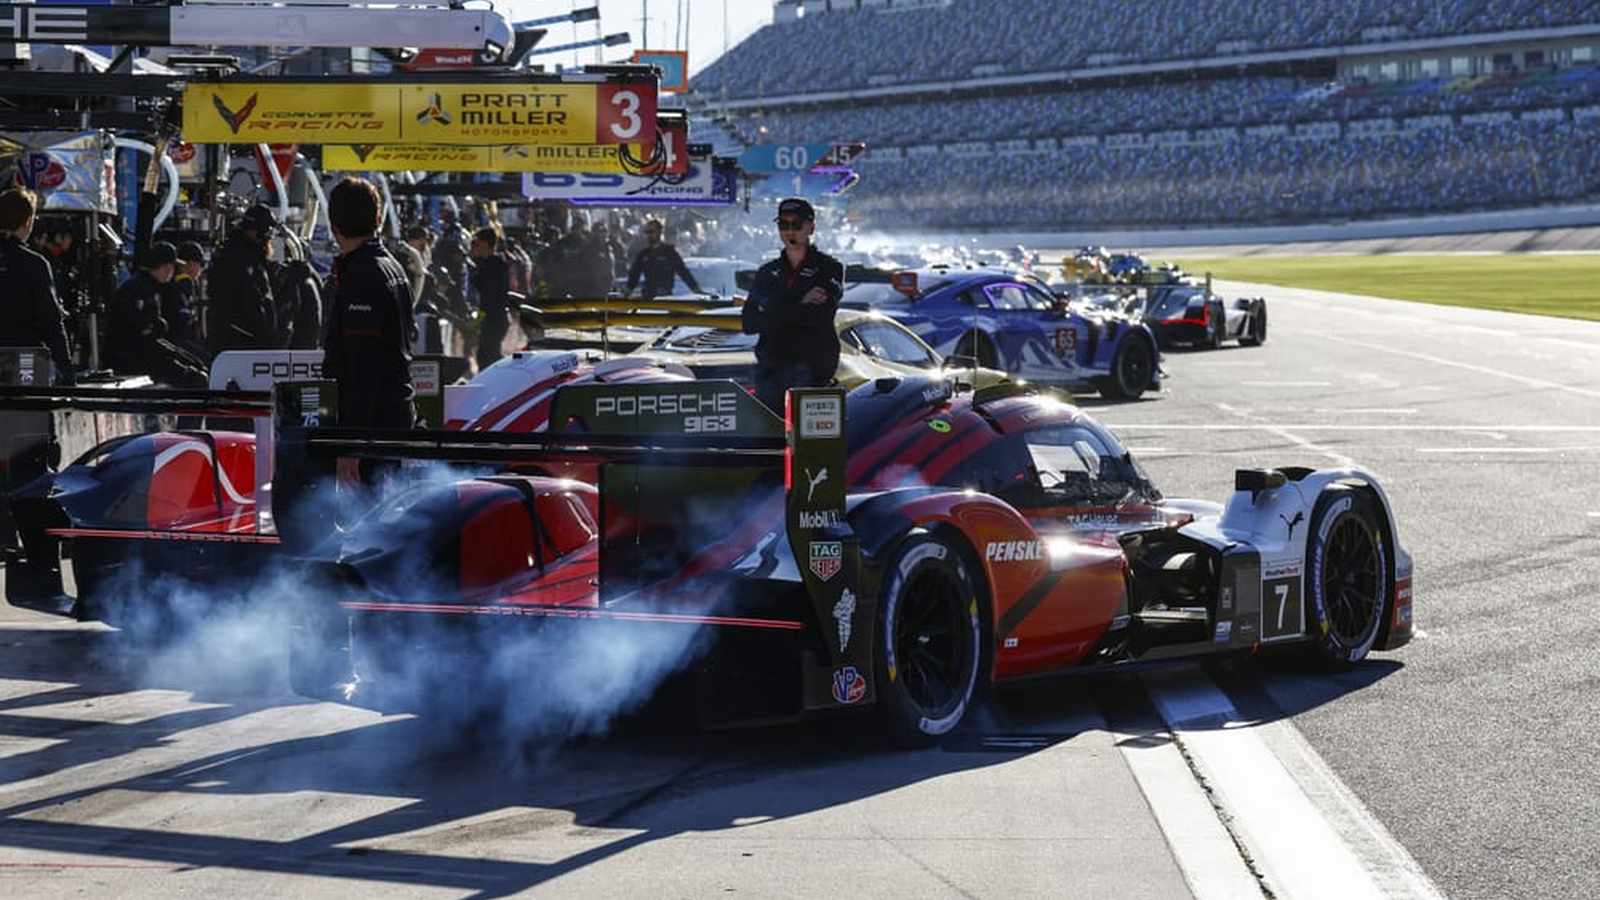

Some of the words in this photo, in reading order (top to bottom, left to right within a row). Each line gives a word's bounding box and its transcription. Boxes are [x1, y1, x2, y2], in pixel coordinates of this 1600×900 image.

[461, 93, 568, 108] PRATT
[461, 111, 567, 125] MILLER
[610, 91, 642, 139] 3
[248, 120, 384, 130] RACING
[537, 147, 619, 158] MILLER
[775, 146, 808, 170] 60
[595, 392, 737, 416] PORSCHE
[684, 415, 737, 433] 963
[799, 510, 829, 528] Mobil
[812, 544, 840, 556] TAG
[1274, 584, 1289, 630] 7
